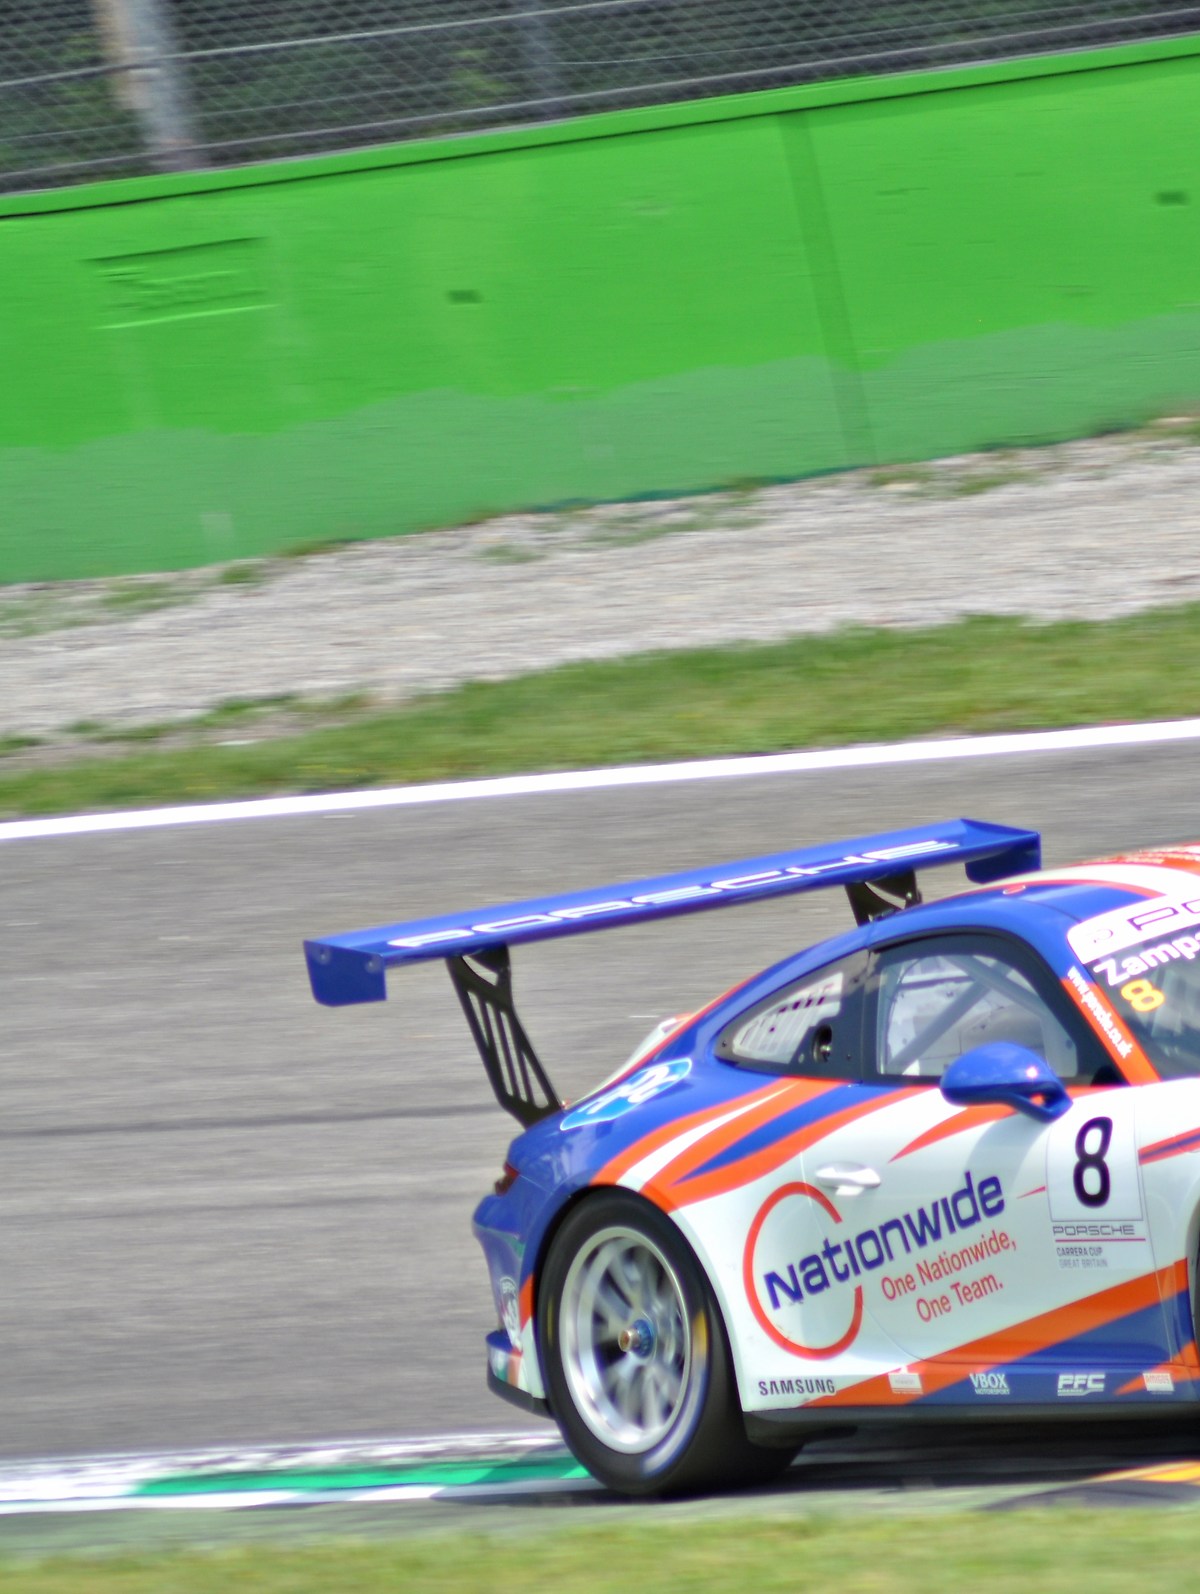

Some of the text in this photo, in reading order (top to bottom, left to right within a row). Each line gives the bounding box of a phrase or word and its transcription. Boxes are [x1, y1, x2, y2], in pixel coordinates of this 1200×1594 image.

[387, 839, 961, 948] PORSCHE
[1120, 977, 1166, 1013] 8
[1073, 1115, 1113, 1209] 8
[763, 1170, 1006, 1311] Nationwide
[1052, 1224, 1136, 1236] PORSCHE
[881, 1229, 1018, 1301] One Nationwide,
[1056, 1246, 1103, 1257] CARRERA CUP
[916, 1273, 1004, 1323] One Team.
[758, 1378, 836, 1397] SAMSUNG
[969, 1372, 1008, 1389] VBOX
[1058, 1373, 1106, 1389] PFC
